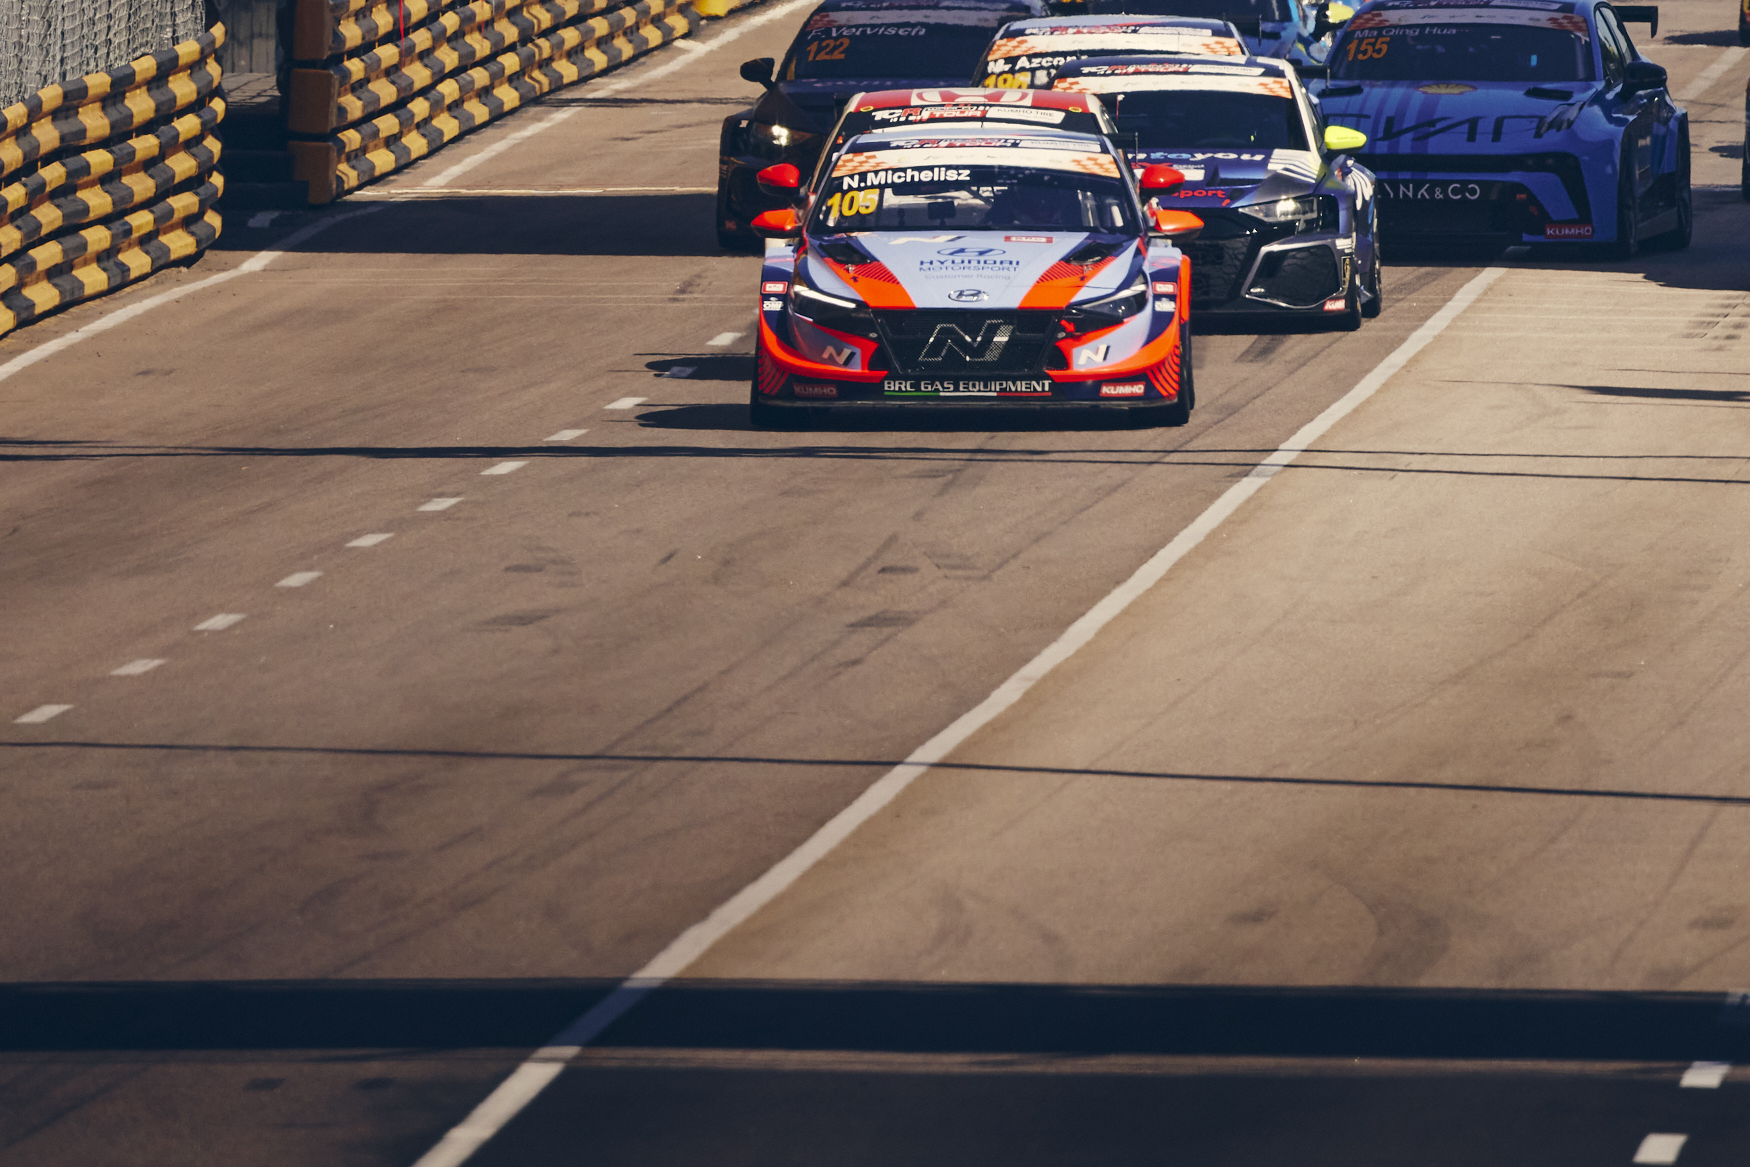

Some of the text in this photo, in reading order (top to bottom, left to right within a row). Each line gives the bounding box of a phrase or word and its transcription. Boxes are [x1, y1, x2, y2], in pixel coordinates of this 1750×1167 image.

[1354, 26, 1456, 39] Ma Qing Hua
[806, 38, 850, 62] 122
[1346, 37, 1391, 62] 155
[842, 167, 971, 191] N.Michelisz
[1377, 183, 1481, 200] YNK&CO
[827, 188, 881, 218] 105
[1546, 226, 1592, 236] KUMHO
[919, 259, 1020, 267] HYUNDAI
[919, 265, 1020, 273] MOTORSPORT
[924, 273, 1011, 281] Customer Racing
[794, 384, 837, 397] KUMHO
[884, 380, 1052, 393] BRC GAS EQUIPMENT
[1102, 383, 1145, 396] KUMHO
